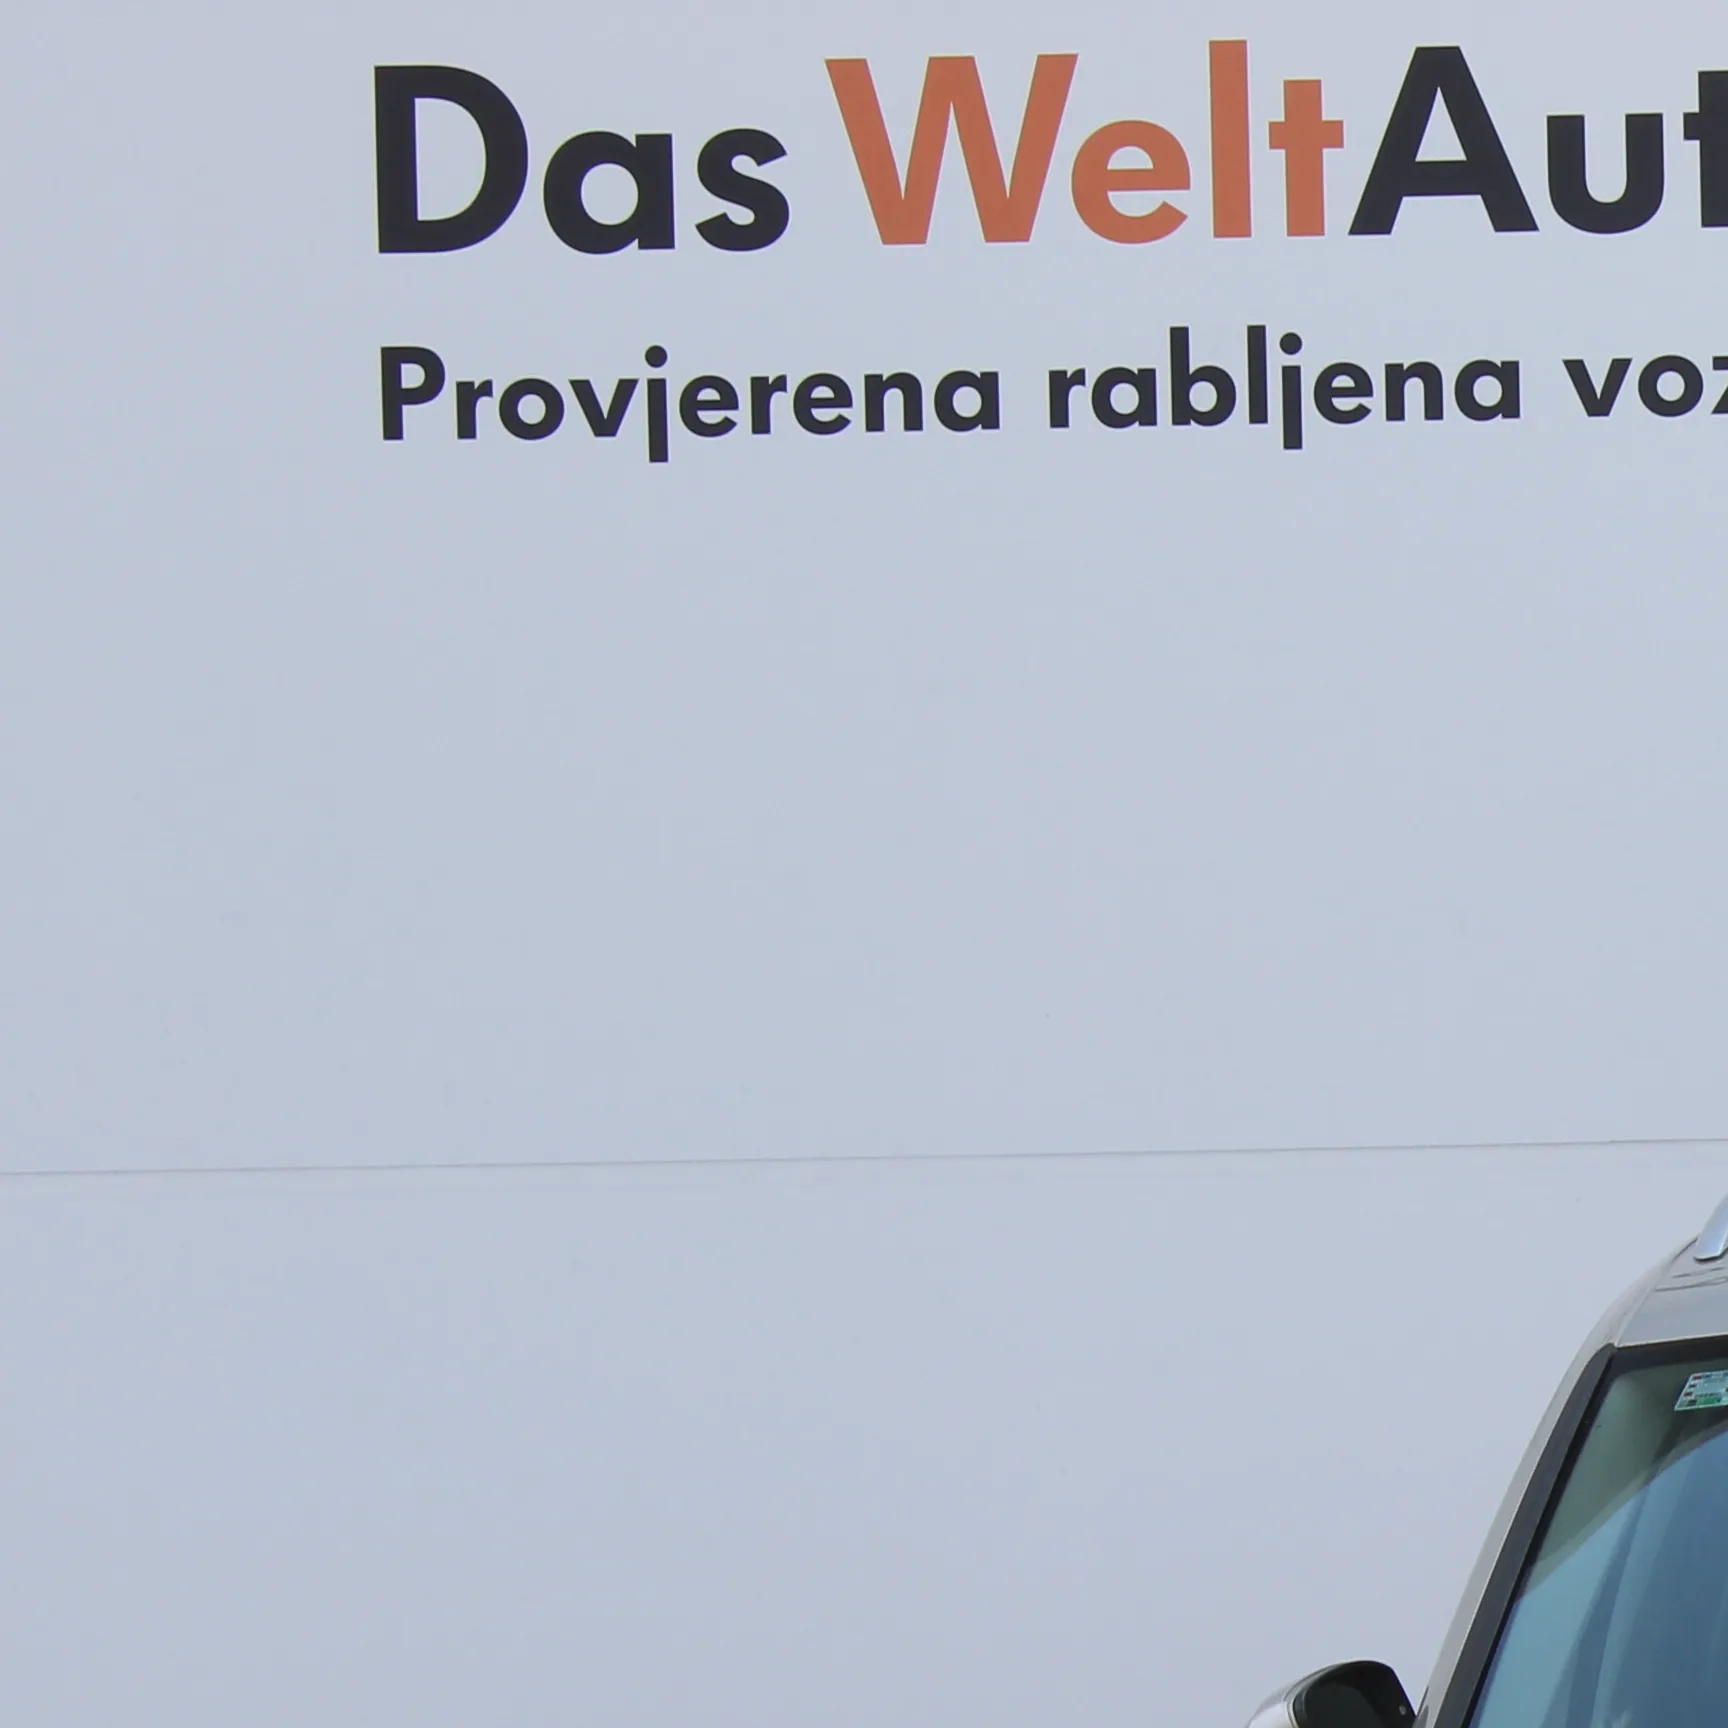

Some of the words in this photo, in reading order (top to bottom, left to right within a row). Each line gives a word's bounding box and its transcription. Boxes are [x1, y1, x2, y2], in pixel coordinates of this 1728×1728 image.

[374, 65, 789, 255] Das
[381, 345, 1000, 463] Provjerena
[1049, 325, 1520, 450] rabljena
